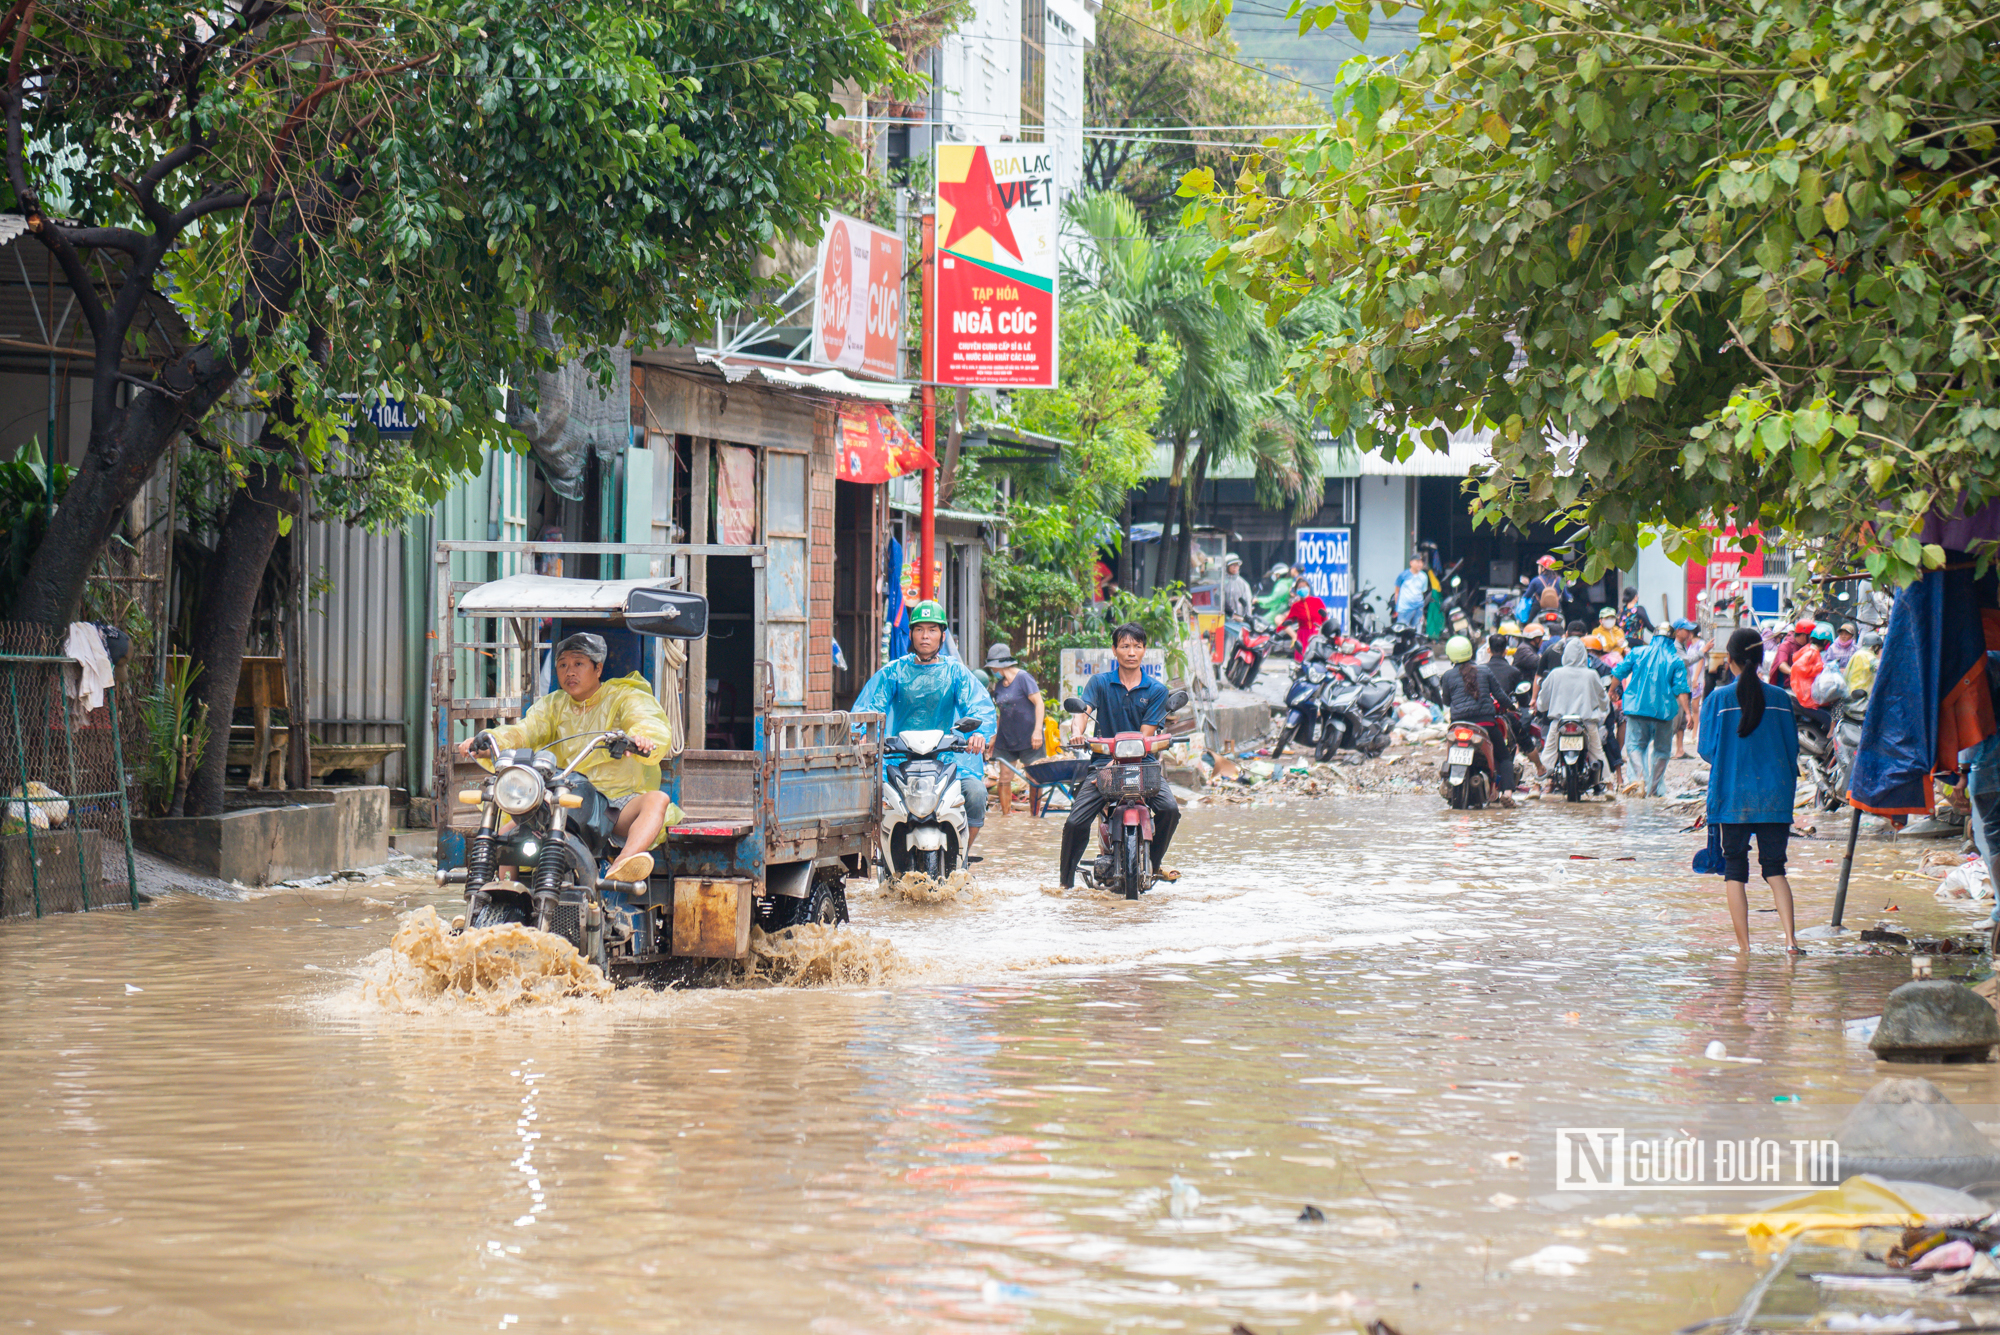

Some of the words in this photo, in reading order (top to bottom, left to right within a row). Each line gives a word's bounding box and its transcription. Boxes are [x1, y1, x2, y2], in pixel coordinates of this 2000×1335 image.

[994, 157, 1022, 176] BIA
[996, 175, 1052, 212] VIỆT
[867, 270, 898, 340] CÚC
[972, 287, 994, 304] TẠP
[996, 284, 1019, 301] HÓA
[953, 306, 993, 334] NGÃ
[998, 306, 1037, 334] CÚC
[982, 342, 997, 350] CUNG
[1299, 534, 1326, 564] TÓC
[1326, 534, 1348, 564] DÀI
[1710, 562, 1740, 579] EM
[1330, 573, 1348, 596] TAI
